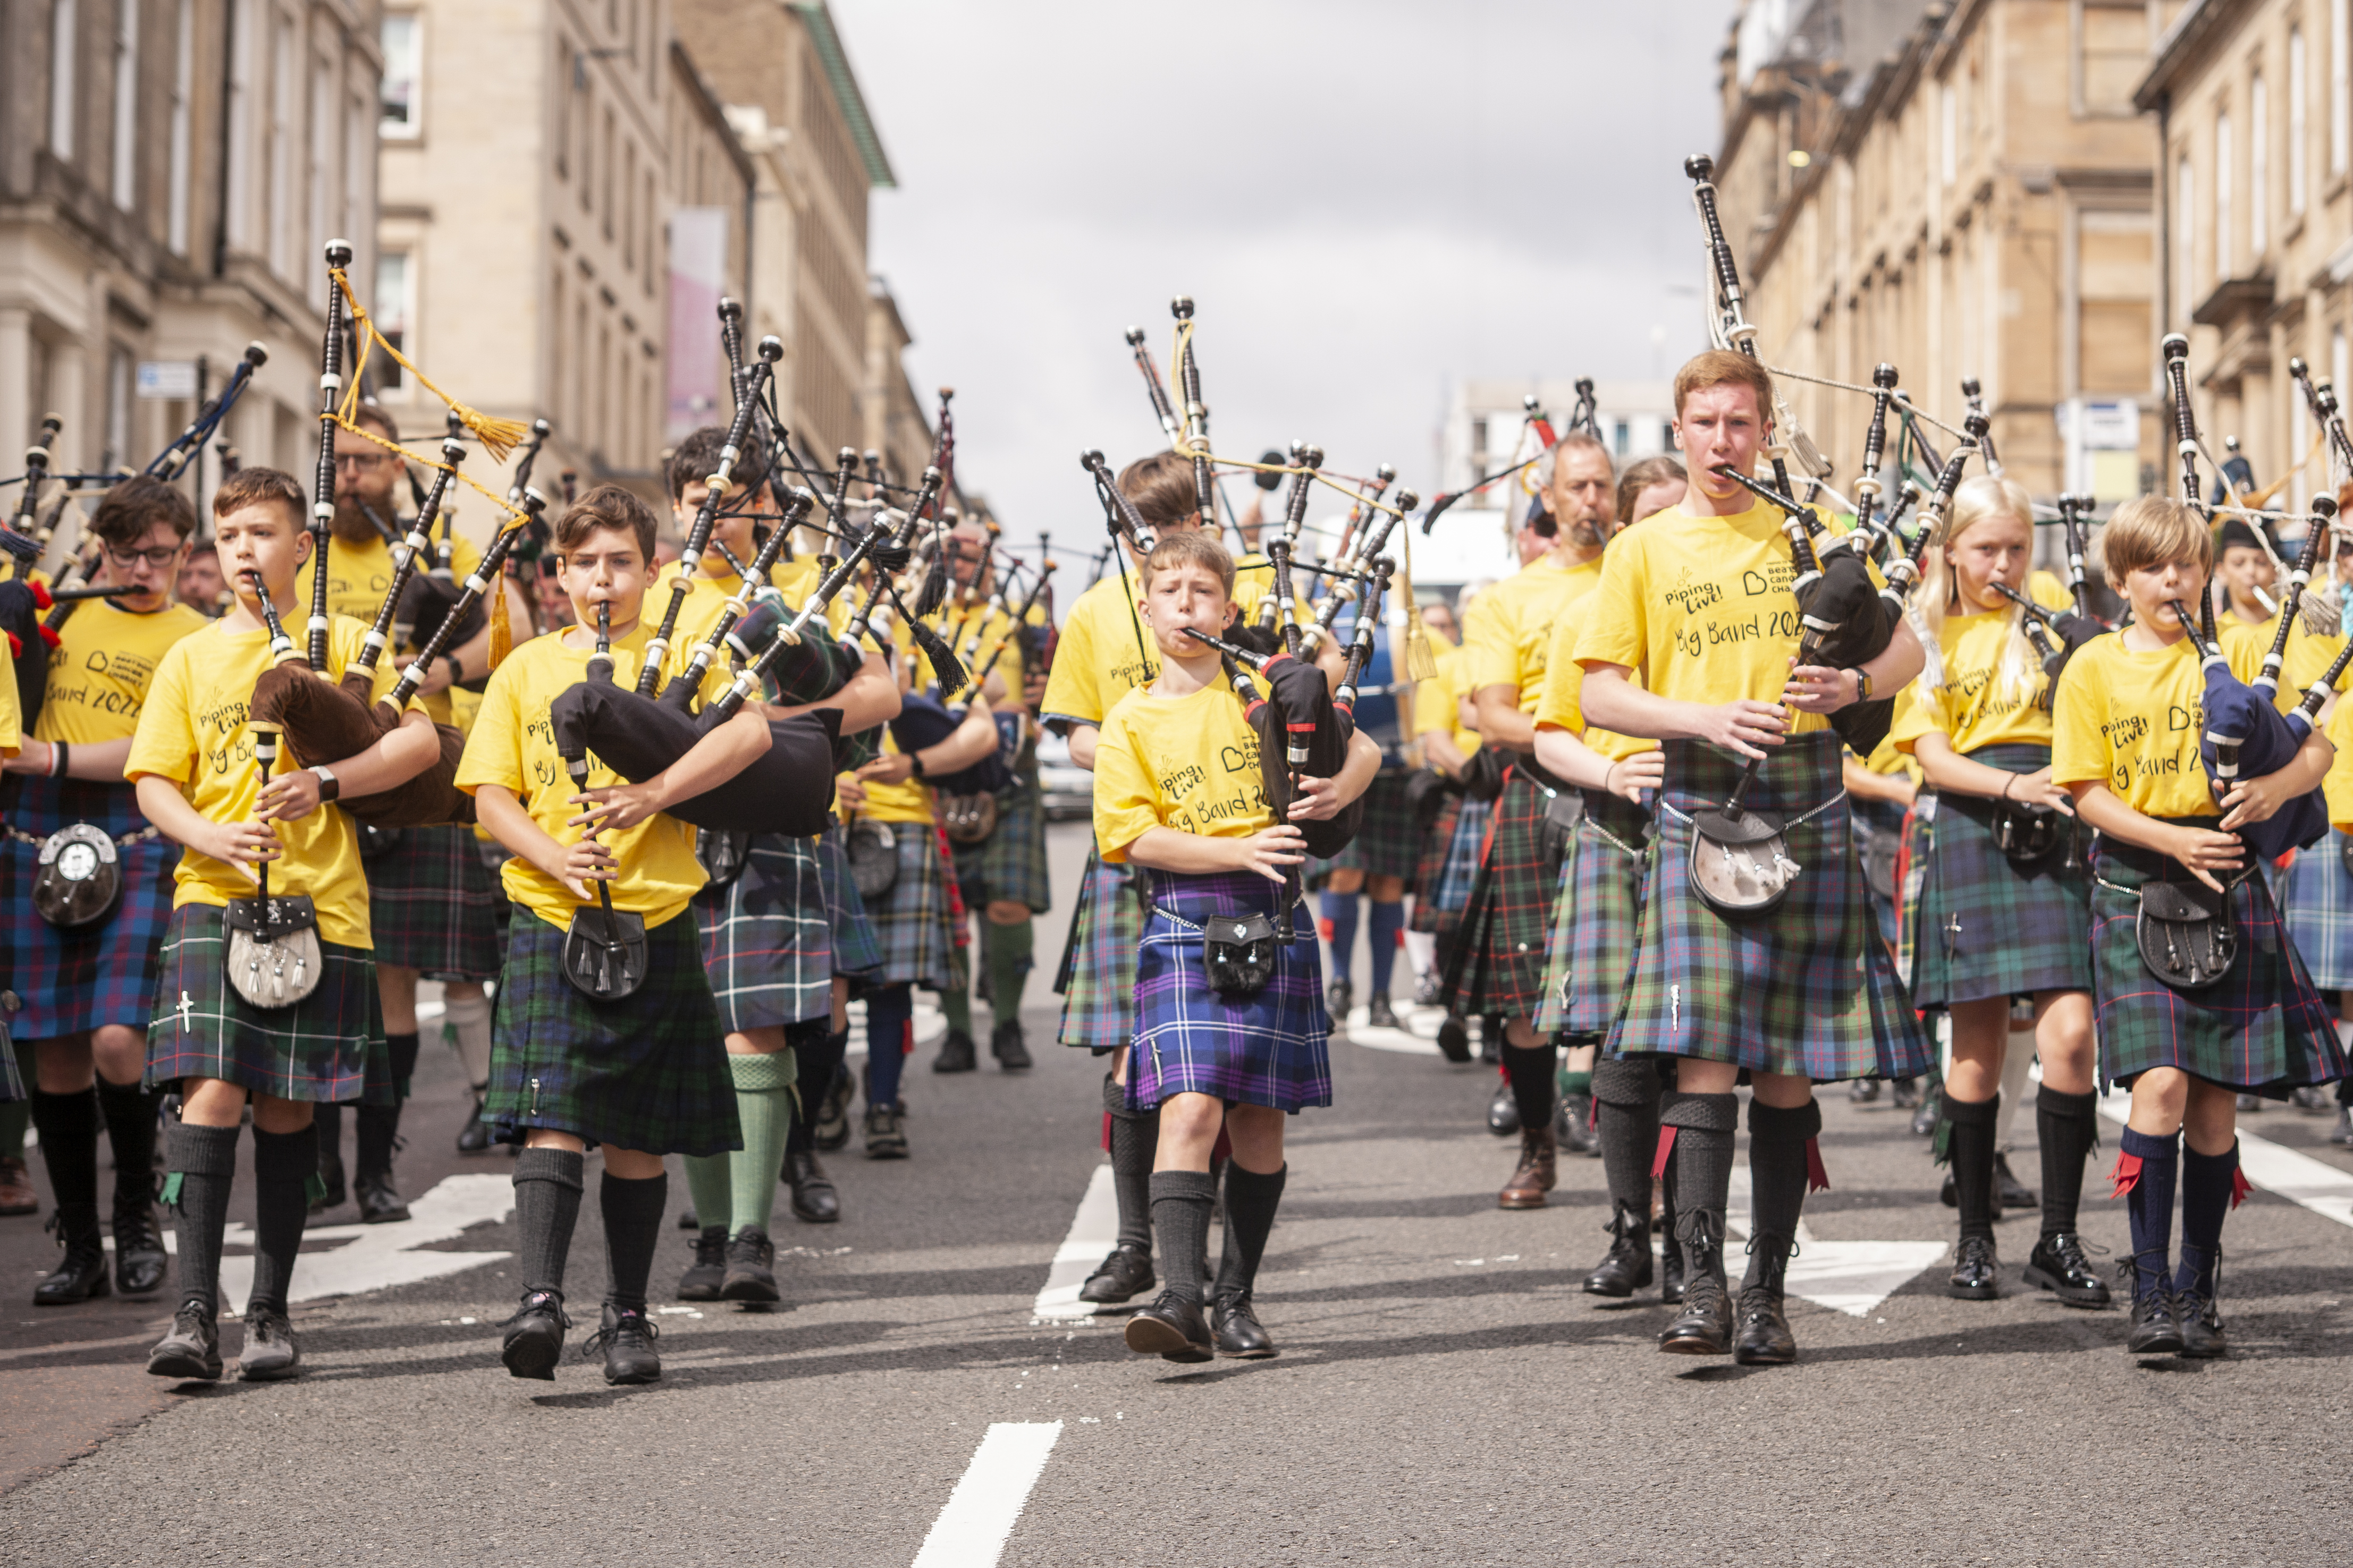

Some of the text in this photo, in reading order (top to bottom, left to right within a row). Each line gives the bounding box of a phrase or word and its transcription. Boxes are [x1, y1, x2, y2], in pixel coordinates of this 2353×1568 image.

[1665, 582, 1714, 605] Piping
[1686, 584, 1723, 615] Live!
[1675, 611, 1806, 657] Big Band 202
[200, 702, 244, 727] Piping
[2114, 717, 2149, 749] Live!
[1158, 765, 1196, 792] iping
[1172, 766, 1207, 800] Live!
[1195, 788, 1248, 824] Band
